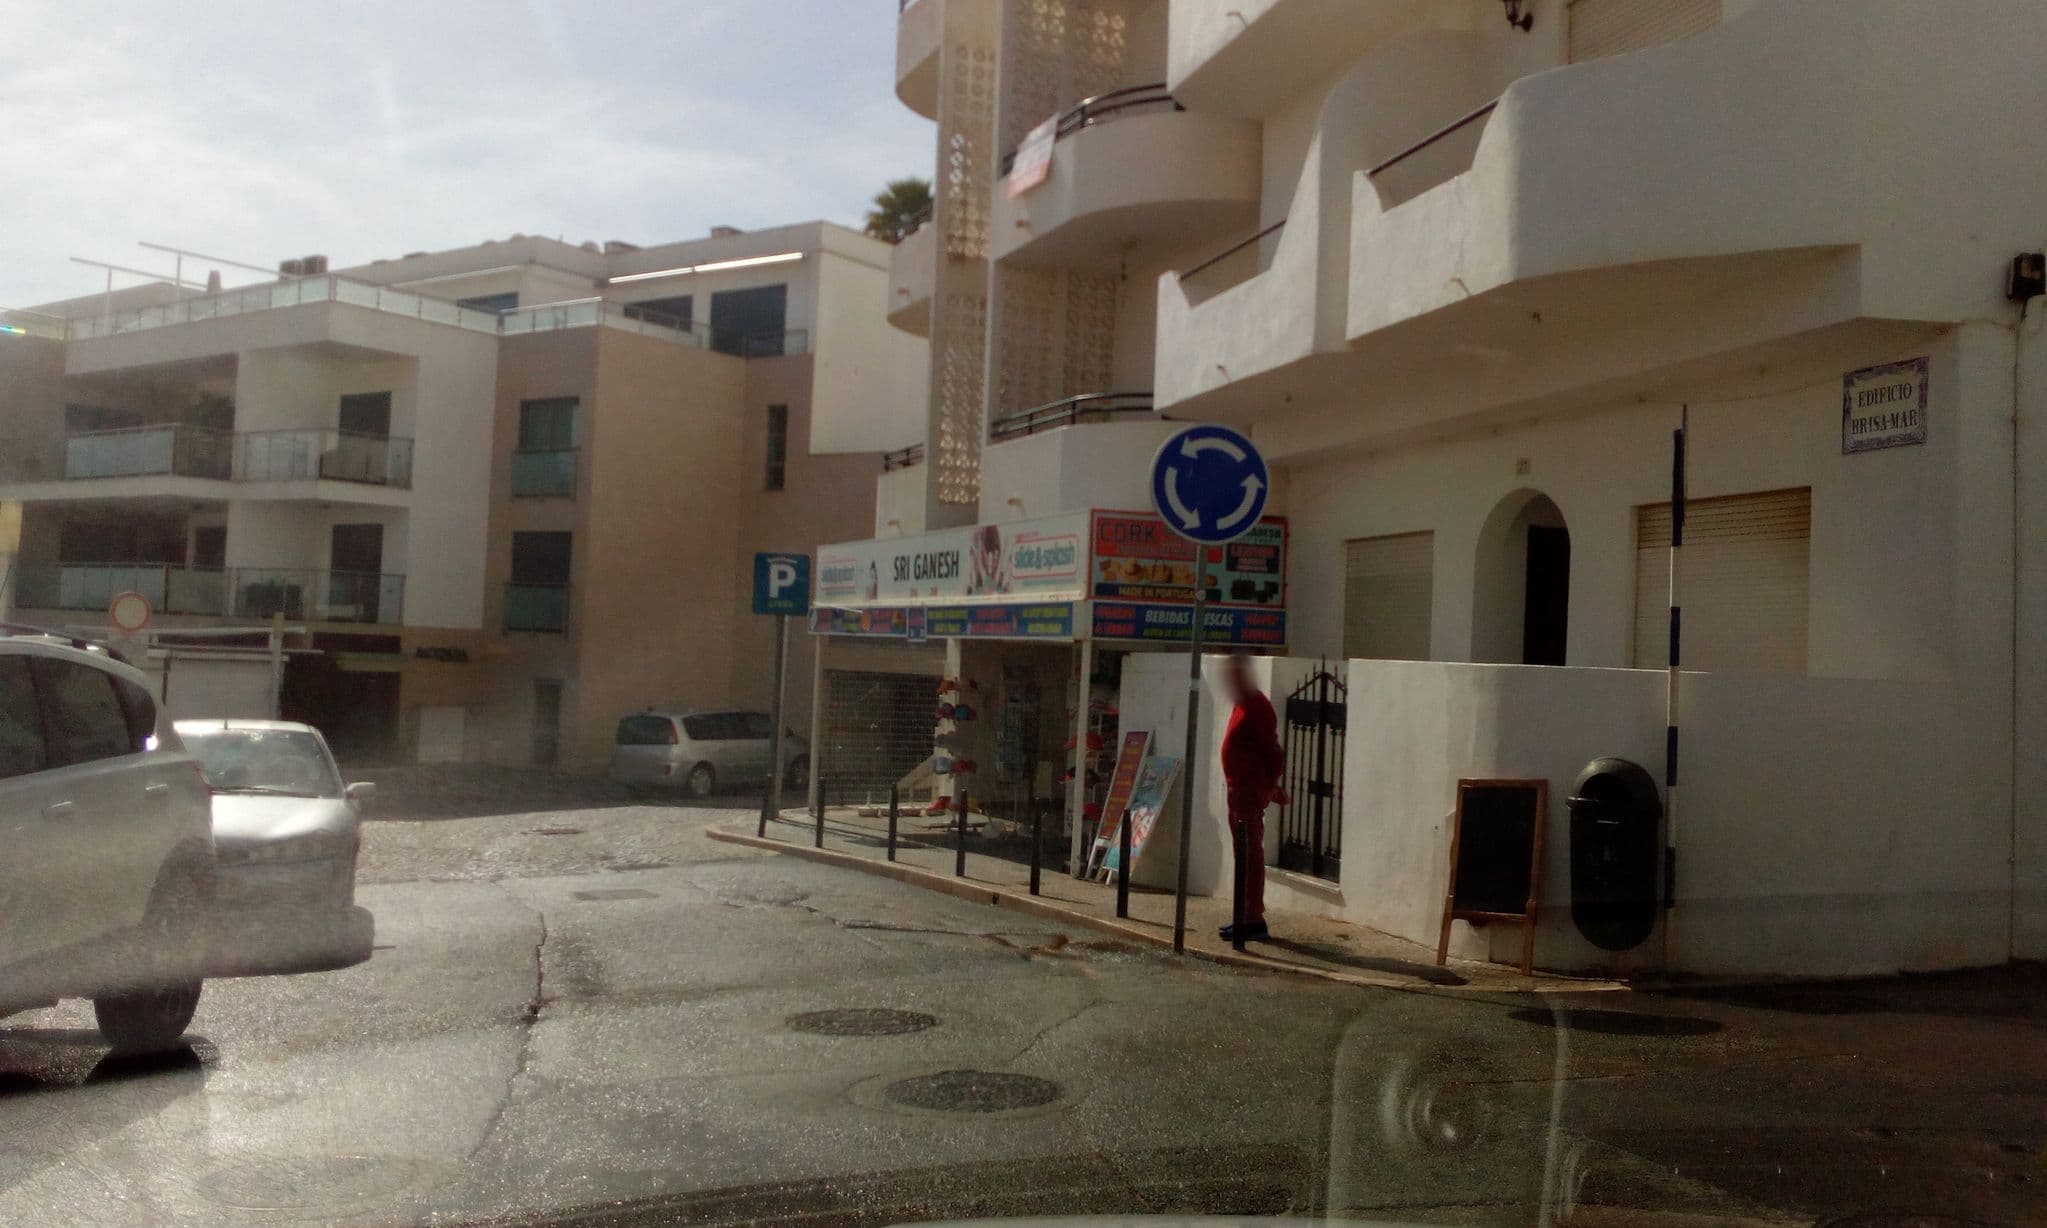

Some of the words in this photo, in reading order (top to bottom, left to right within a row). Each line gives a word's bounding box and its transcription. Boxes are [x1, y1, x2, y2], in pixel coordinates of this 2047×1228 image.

[1858, 382, 1912, 408] EDIFICIO
[1851, 409, 1917, 435] BRISA-MAR
[1100, 521, 1155, 544] CORK
[893, 555, 910, 582] SRI
[913, 551, 960, 580] GANESH
[769, 563, 796, 598] P
[1155, 587, 1196, 600] PORTUGA
[1145, 609, 1190, 625] BEBIDAS
